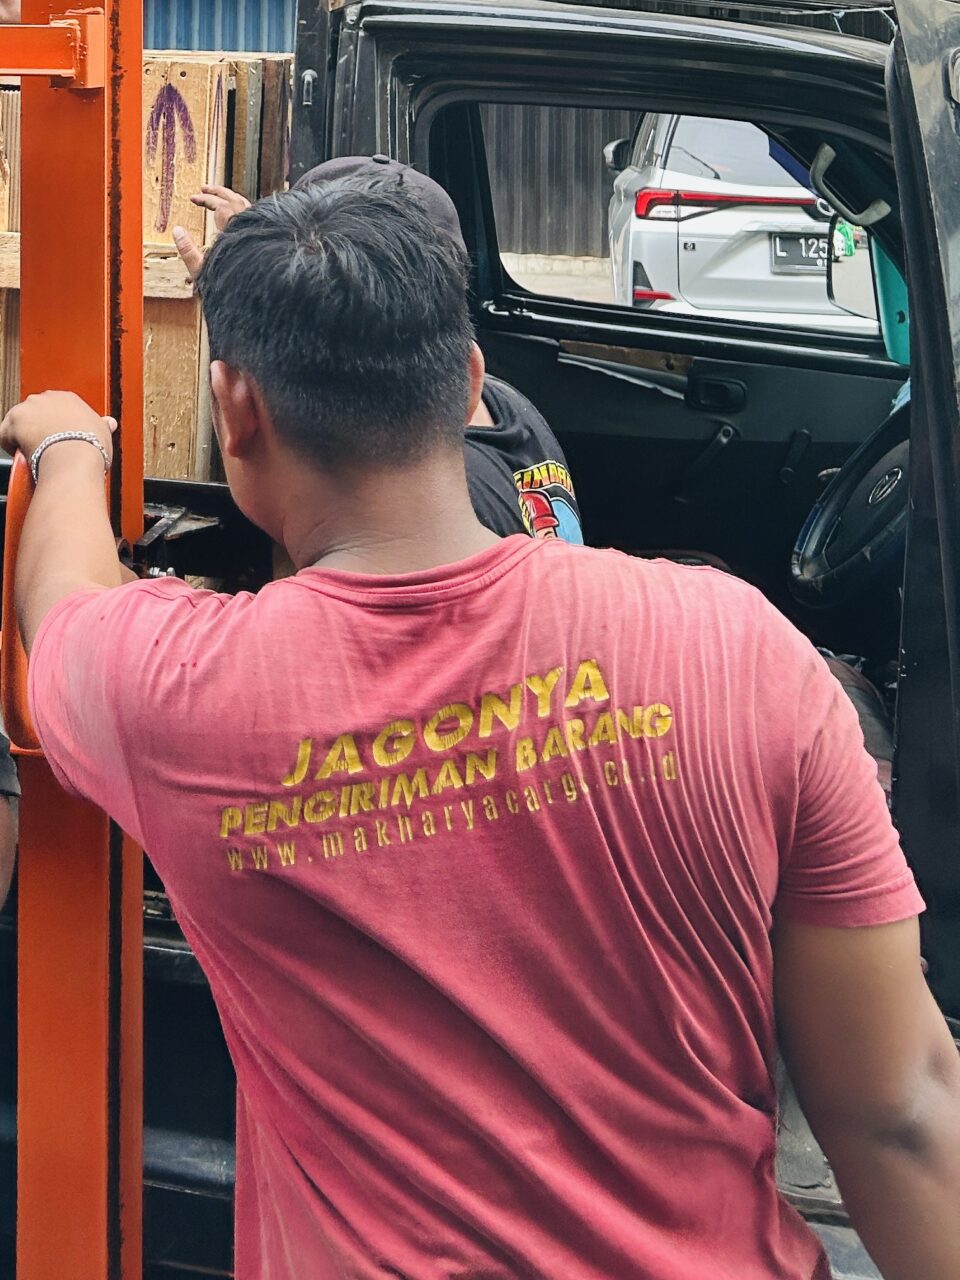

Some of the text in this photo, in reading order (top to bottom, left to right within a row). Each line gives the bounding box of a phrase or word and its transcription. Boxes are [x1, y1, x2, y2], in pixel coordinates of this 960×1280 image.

[775, 237, 829, 258] L 125
[219, 703, 675, 838] PENGIRIMAN BARANG
[281, 658, 610, 787] JAGONYA
